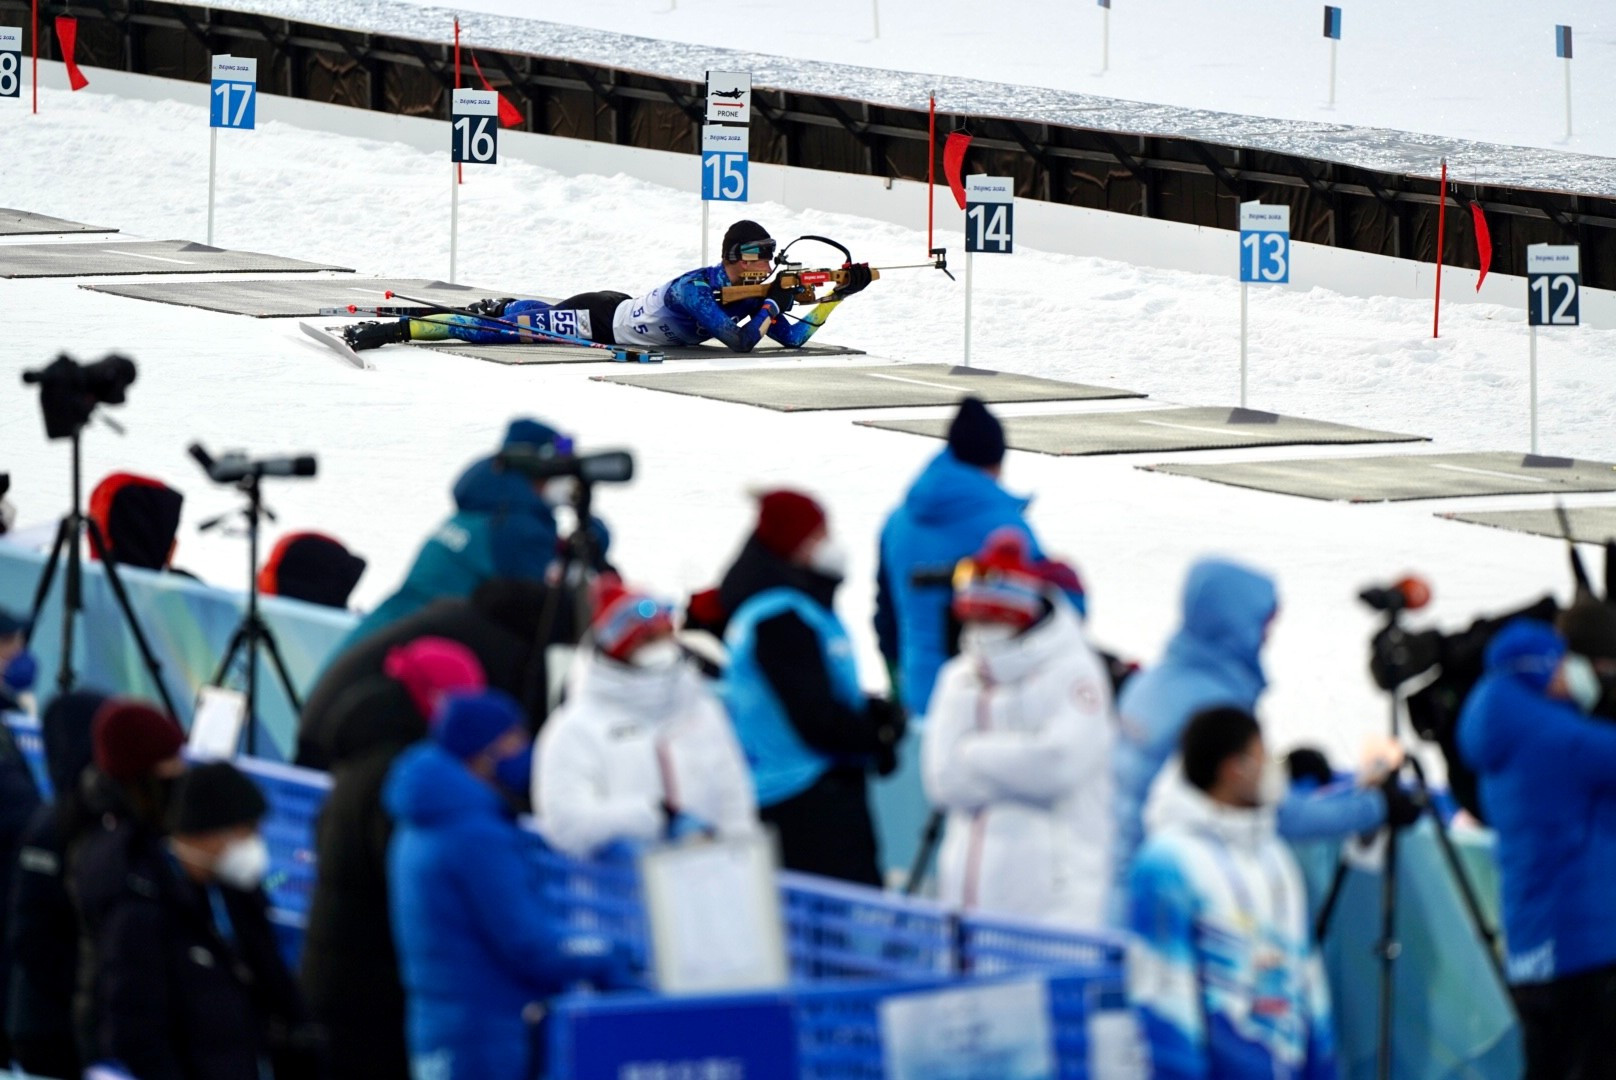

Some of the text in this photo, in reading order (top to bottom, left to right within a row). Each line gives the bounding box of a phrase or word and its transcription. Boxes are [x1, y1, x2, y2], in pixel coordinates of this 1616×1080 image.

[214, 83, 253, 126] 17
[717, 110, 739, 118] PRONE
[454, 117, 494, 162] 16
[704, 154, 744, 199] 15
[968, 204, 1011, 251] 14
[1243, 233, 1286, 281] 13
[1531, 275, 1576, 324] 12
[554, 311, 574, 335] 55
